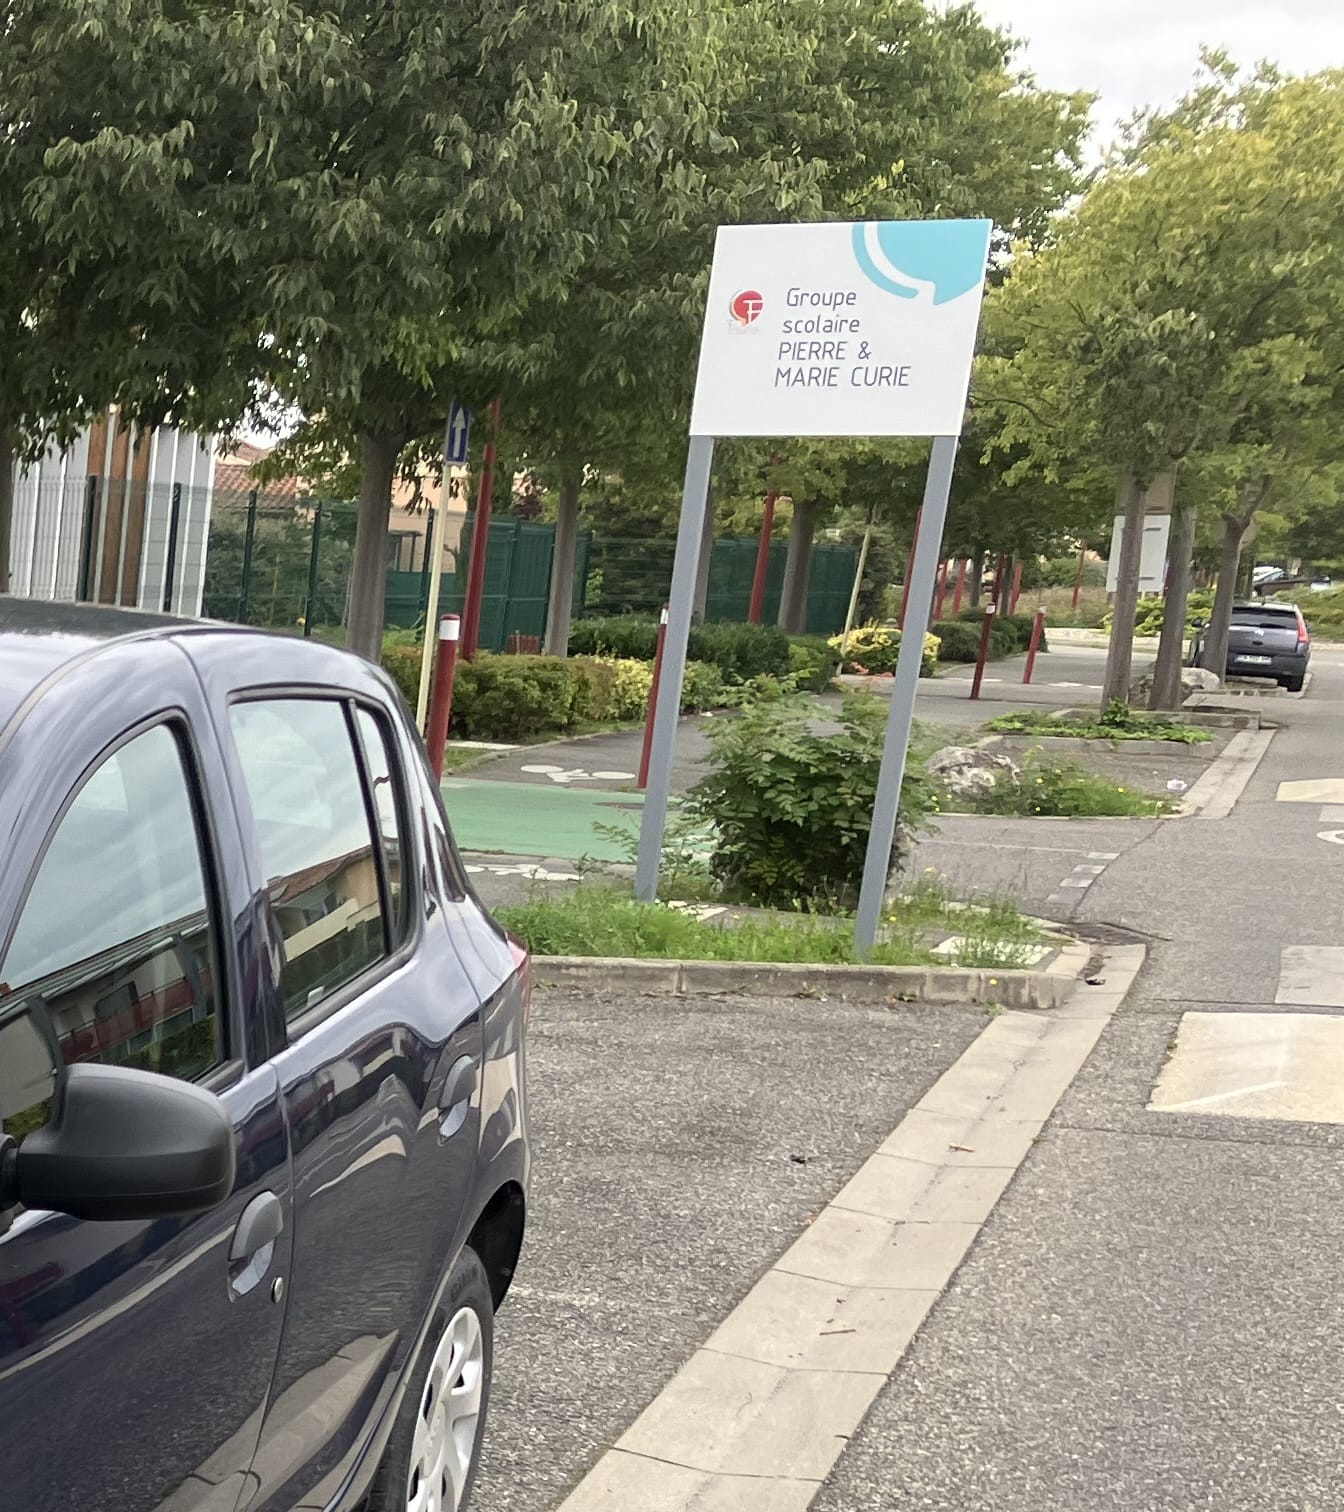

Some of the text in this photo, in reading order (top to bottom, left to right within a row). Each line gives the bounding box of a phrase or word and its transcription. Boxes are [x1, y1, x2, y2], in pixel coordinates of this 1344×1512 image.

[786, 286, 857, 311] Groupe
[782, 313, 860, 334] scolaire
[778, 340, 872, 360] PIERRE &
[775, 365, 912, 387] MARIE CURIE
